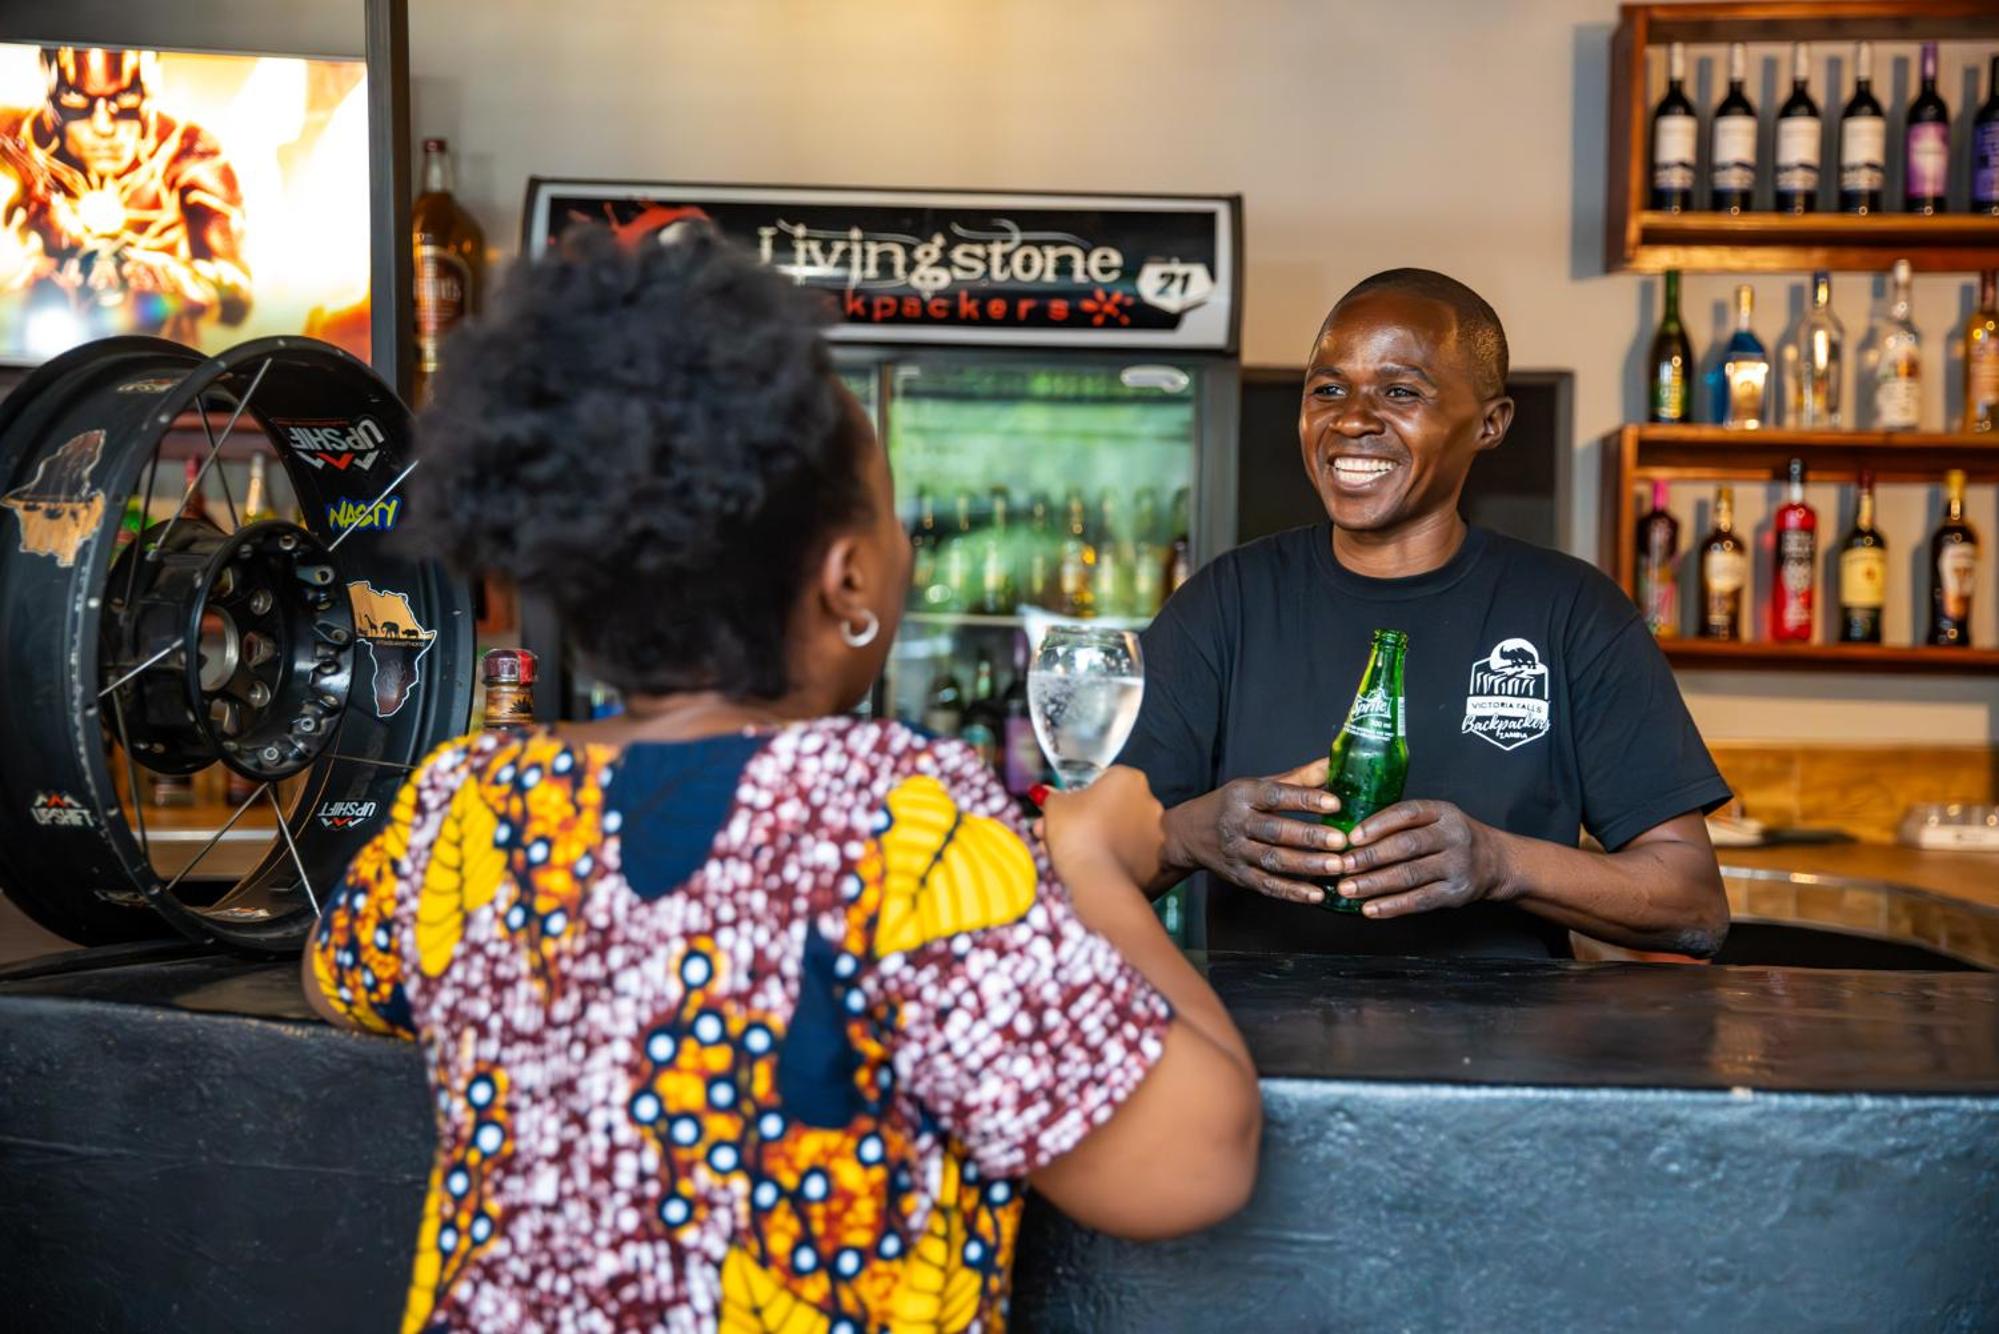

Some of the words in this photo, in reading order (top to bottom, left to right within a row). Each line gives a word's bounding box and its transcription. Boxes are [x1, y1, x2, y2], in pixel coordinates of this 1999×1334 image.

[757, 220, 1125, 299] Livingstone
[820, 289, 1070, 322] kpackers
[328, 499, 399, 528] NASTY
[1471, 701, 1513, 710] VICTORIA
[1516, 703, 1543, 714] FALLS
[1461, 712, 1552, 737] Backpackers
[31, 807, 95, 827] UPSHIFT
[317, 801, 377, 817] UPSHIFT
